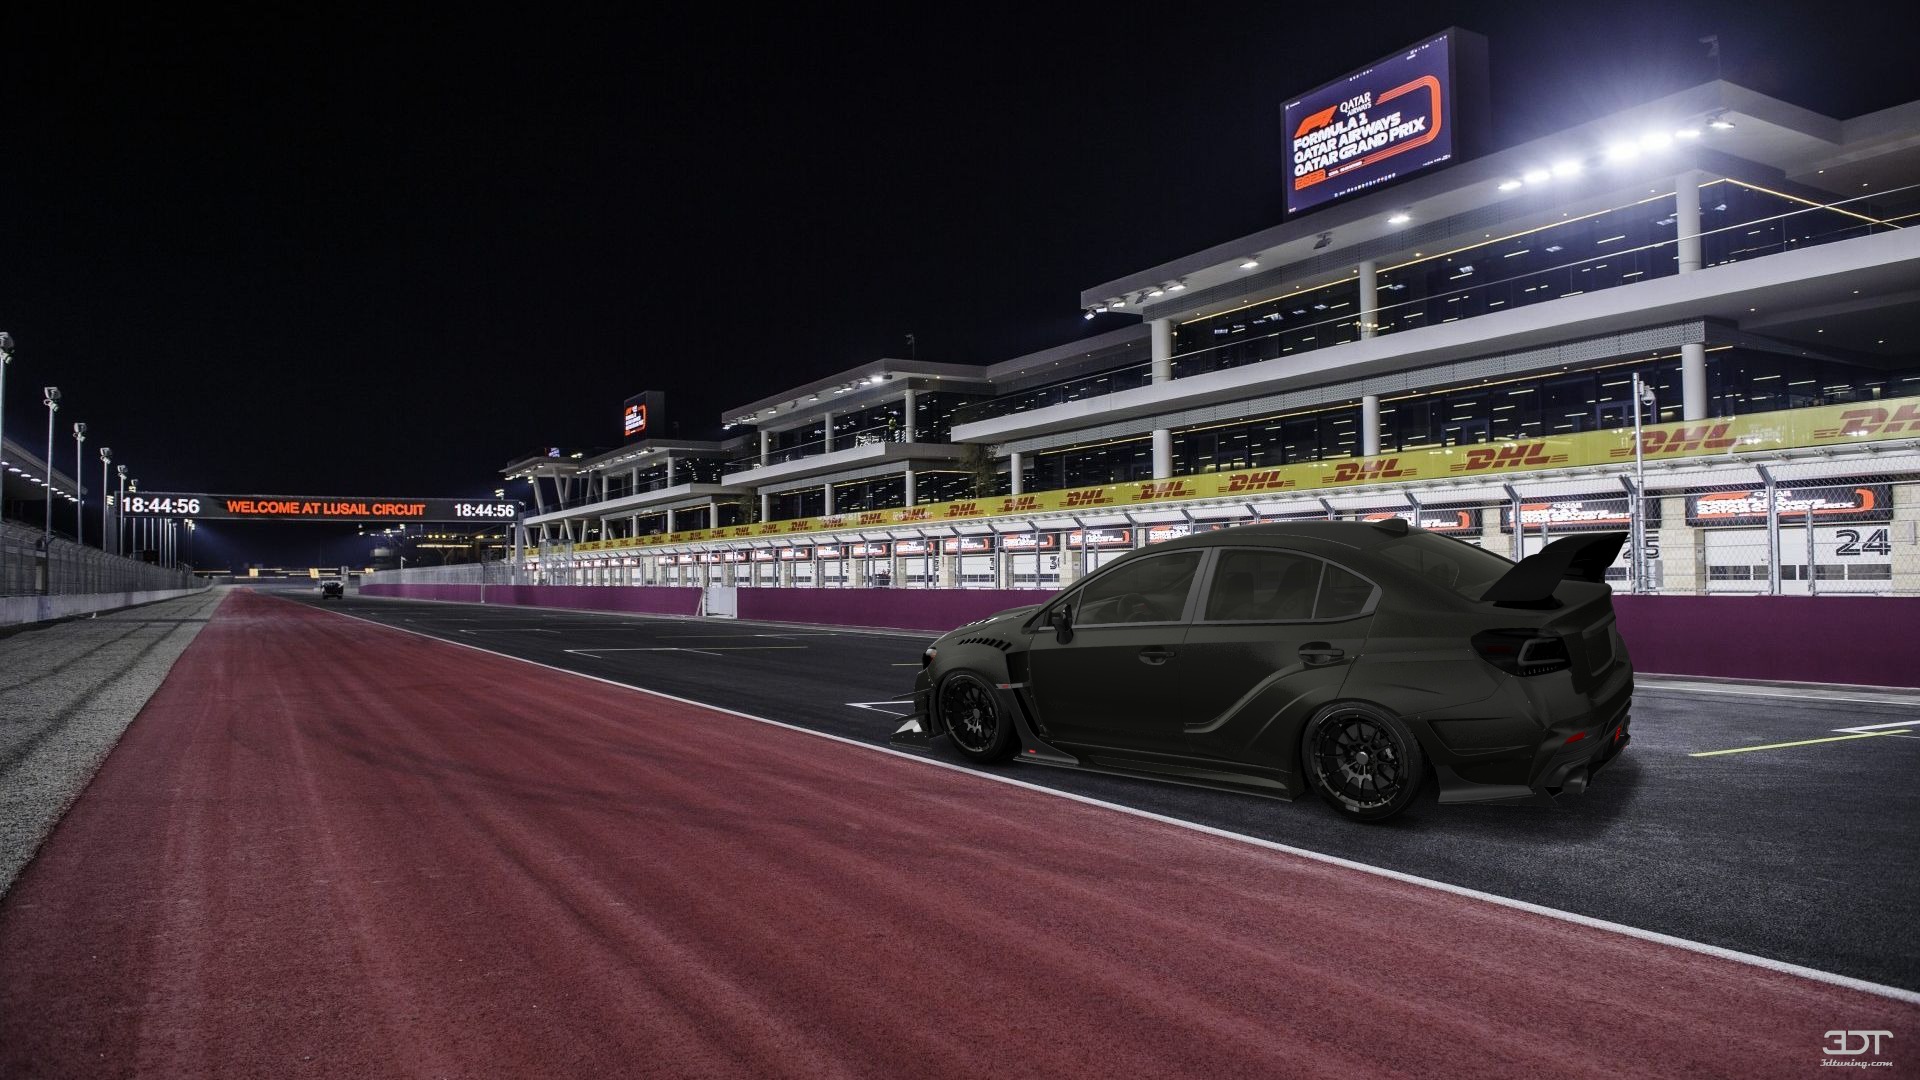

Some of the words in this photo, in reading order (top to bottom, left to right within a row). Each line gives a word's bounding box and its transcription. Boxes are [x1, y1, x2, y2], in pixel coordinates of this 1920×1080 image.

[1340, 92, 1371, 113] QATAR
[1294, 117, 1358, 152] FORMULA
[1359, 112, 1369, 125] 1
[1294, 138, 1338, 164] QATAR
[1338, 111, 1401, 147] AIRWAYS
[1294, 150, 1339, 177] QATAR
[1339, 131, 1389, 160] GRAND
[1389, 116, 1426, 142] PRIX
[1629, 424, 1740, 455] DHL
[1465, 443, 1551, 470] DHL
[1334, 458, 1403, 482] DHL
[1140, 481, 1187, 500] DHL
[1228, 471, 1285, 492] DHL
[122, 497, 200, 514] 18:44:56
[227, 500, 300, 514] WELCOME
[302, 502, 321, 514] AT
[323, 503, 370, 515] LUSAIL
[372, 503, 425, 516] CIRCUIT
[1003, 496, 1038, 512] DHL
[1067, 489, 1106, 507] DHL
[455, 503, 515, 517] 18:44:56
[949, 502, 979, 517] DHL
[1622, 530, 1660, 560] 5
[1835, 528, 1892, 556] 24
